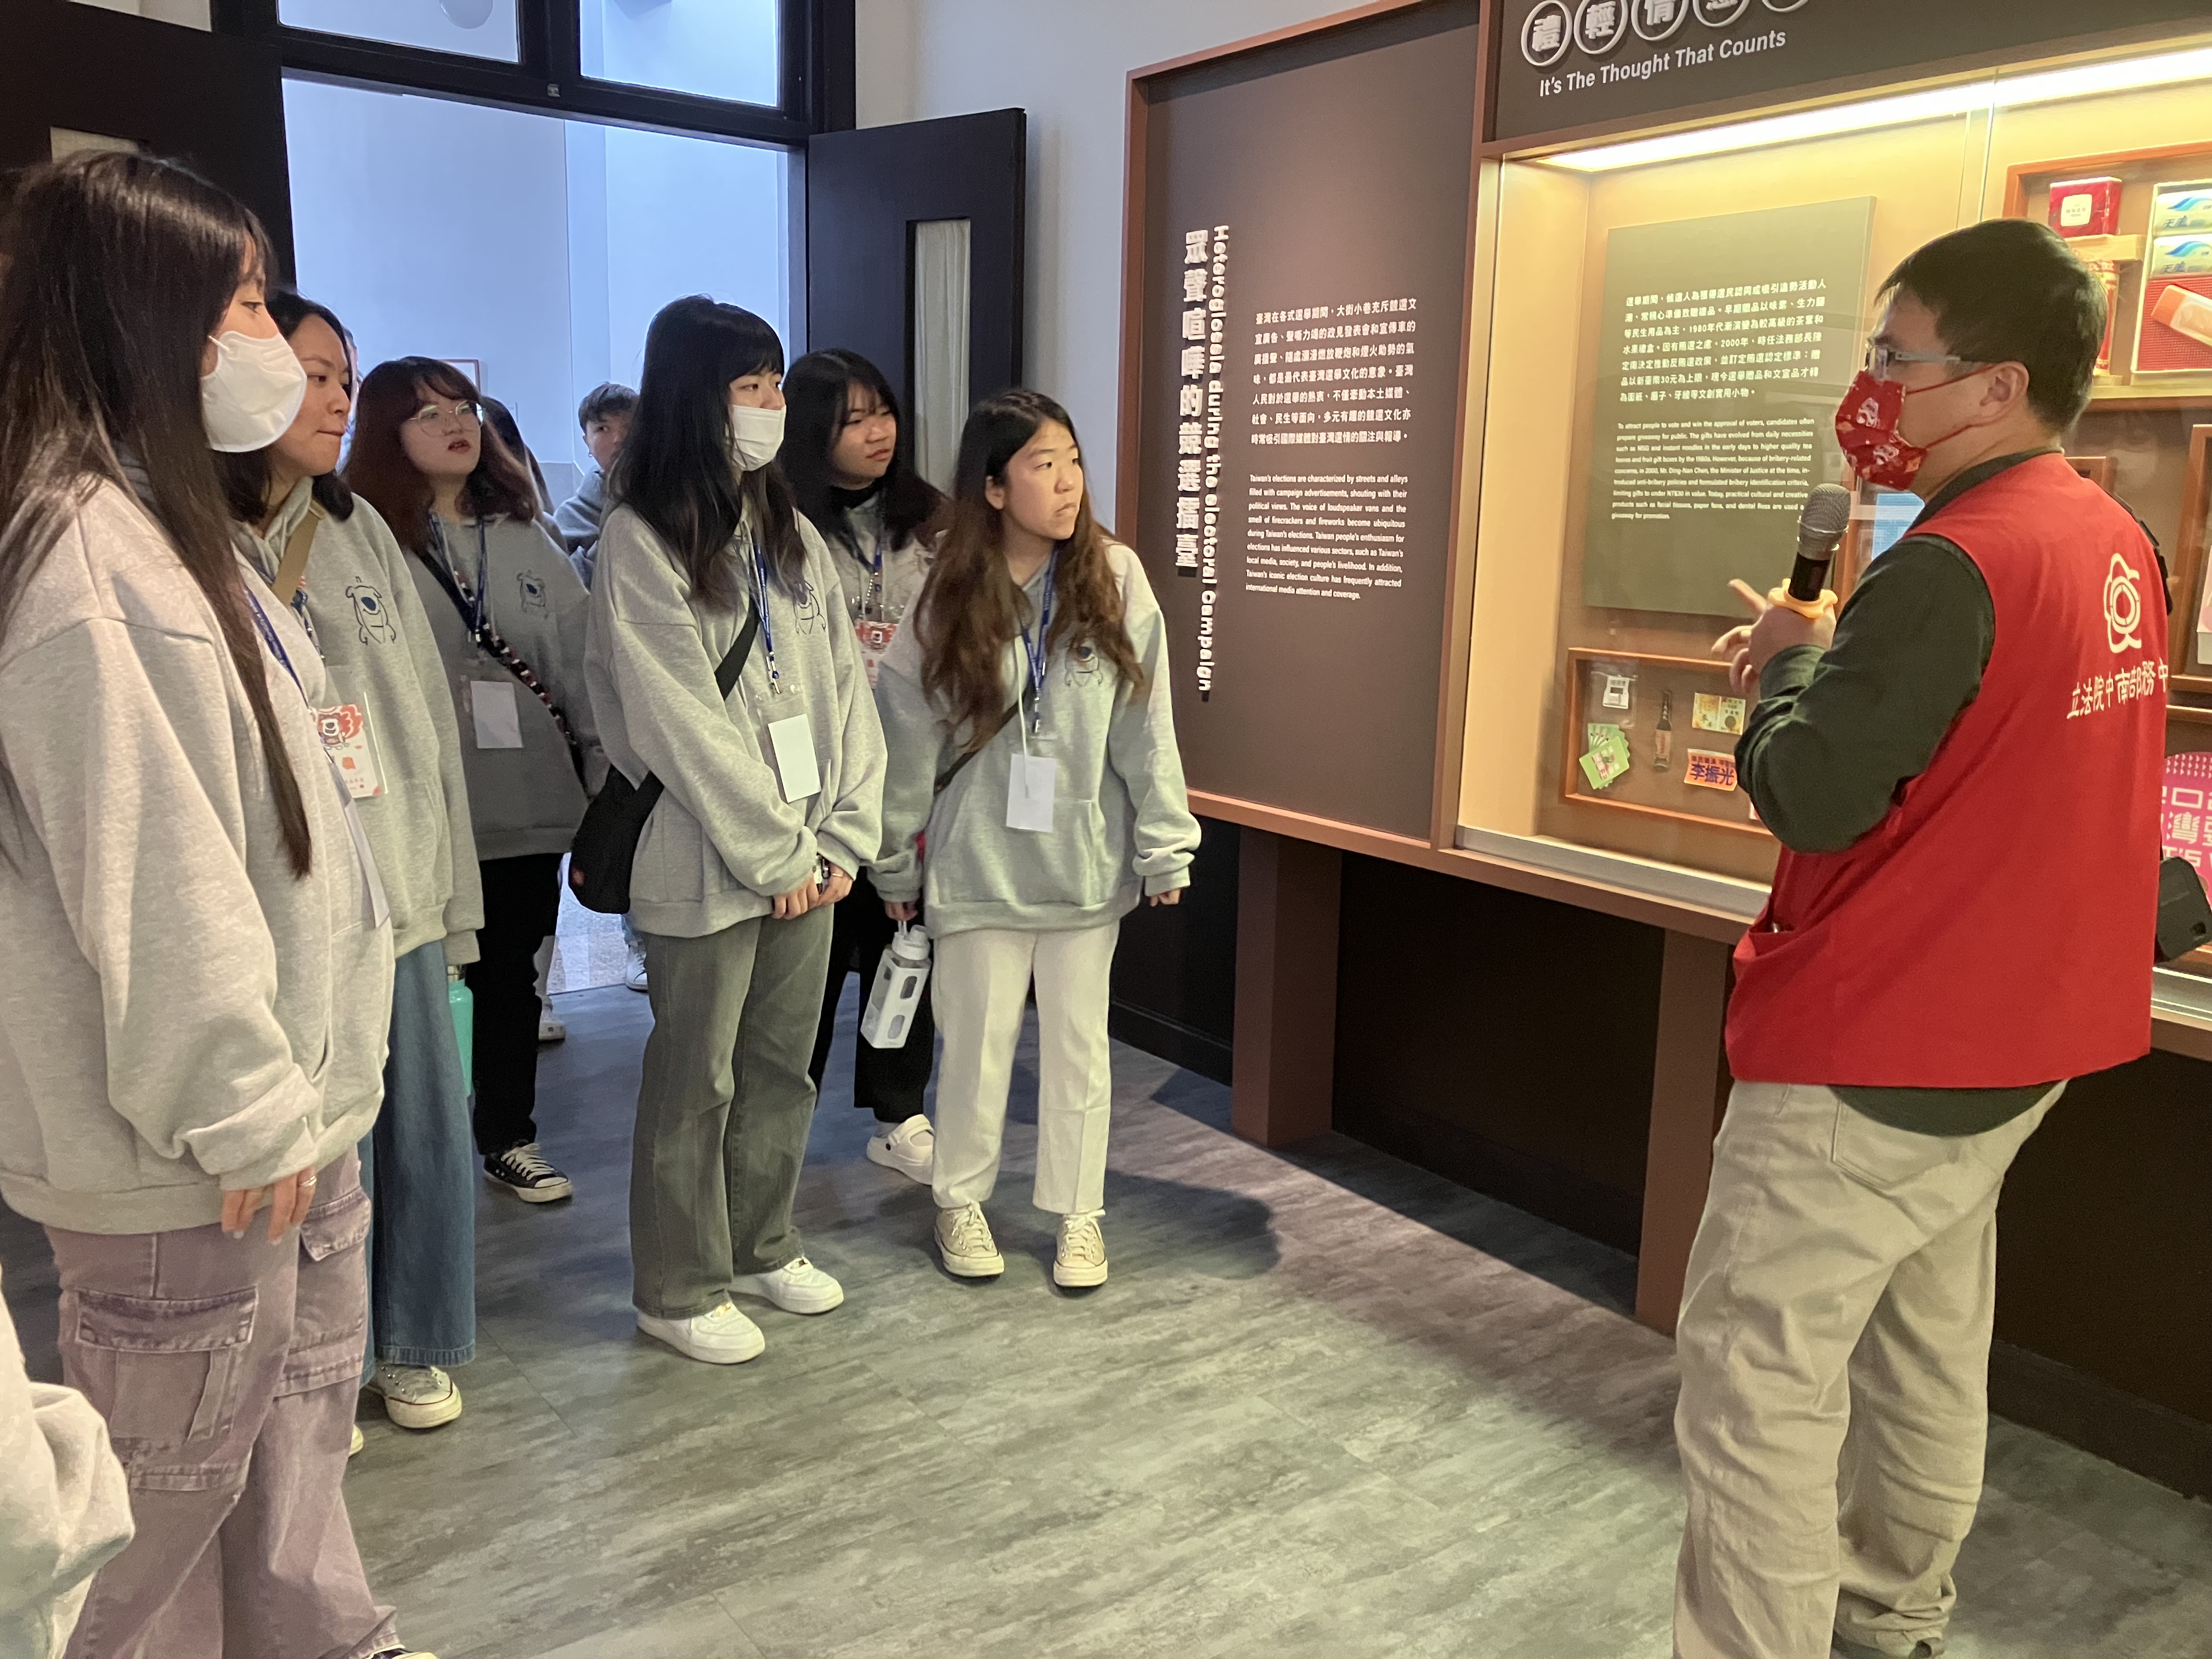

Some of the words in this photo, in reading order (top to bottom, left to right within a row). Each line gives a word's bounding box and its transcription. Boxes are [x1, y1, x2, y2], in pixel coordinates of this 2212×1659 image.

[1539, 77, 1562, 97] It's
[1566, 71, 1595, 91] The
[1600, 53, 1669, 83] Thought
[1675, 43, 1714, 67] That
[1719, 30, 1786, 59] Counts
[1209, 225, 1229, 374] Heteroglossia
[1204, 380, 1223, 448] during
[1205, 454, 1221, 488] the
[1346, 475, 1355, 484] by
[1390, 475, 1408, 484] alleys
[1276, 489, 1303, 498] campaign
[1304, 489, 1348, 498] advertisements,
[1350, 489, 1376, 499] shouting
[1248, 502, 1269, 511] political
[1327, 503, 1363, 513] loudspeaker
[1272, 516, 1304, 524] firecrackers
[1318, 517, 1345, 526] fireworks
[1347, 518, 1371, 527] become
[1373, 519, 1406, 528] ubiquitous
[1202, 494, 1220, 584] electoral
[1247, 529, 1265, 539] during
[1288, 531, 1314, 539] elections.
[1335, 533, 1359, 541] people's
[1395, 534, 1404, 543] for
[1246, 543, 1271, 551] elections
[1281, 544, 1310, 552] influenced
[1331, 548, 1354, 556] sectors,
[1379, 549, 1403, 557] Taiwan's
[1260, 557, 1278, 566] media,
[1279, 558, 1300, 568] society,
[1313, 561, 1336, 569] people's
[1338, 561, 1367, 570] livelihood.
[1376, 563, 1402, 573] addition,
[1246, 569, 1267, 578] Taiwan's
[1268, 571, 1285, 579] iconic
[1286, 572, 1308, 580] election
[1331, 575, 1342, 583] has
[1343, 575, 1373, 587] frequently
[1374, 579, 1402, 587] attracted
[1245, 583, 1278, 592] international
[1333, 591, 1361, 600] coverage.
